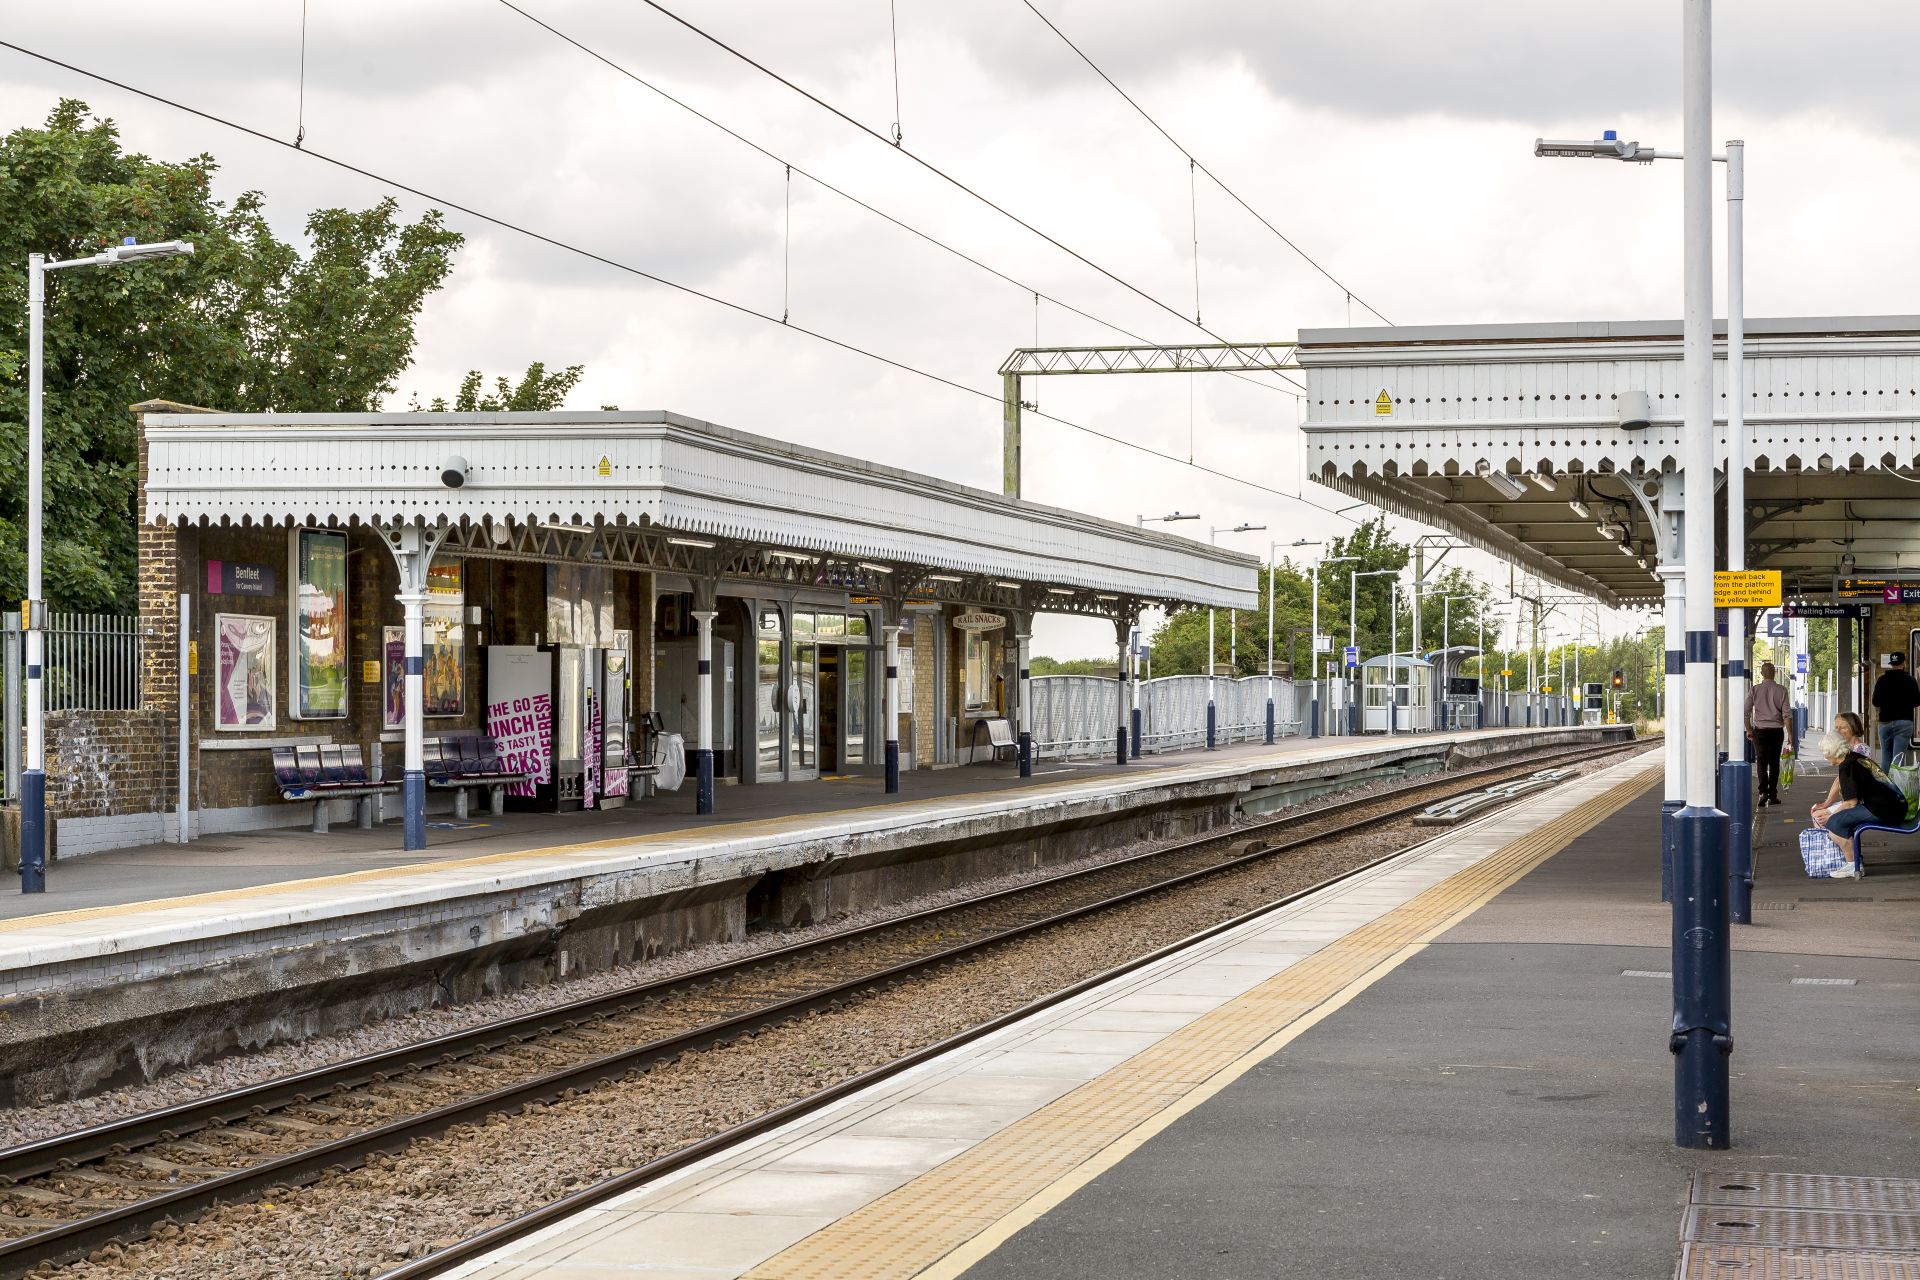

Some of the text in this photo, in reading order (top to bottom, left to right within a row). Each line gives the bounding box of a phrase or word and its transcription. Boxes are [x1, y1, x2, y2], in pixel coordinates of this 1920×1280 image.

[235, 566, 260, 580] Benfleet
[1845, 580, 1851, 589] 2
[1903, 590, 1920, 598] Exit
[1797, 607, 1823, 615] Waiting
[957, 614, 1001, 624] RAIL SNACKS
[1771, 617, 1784, 634] 2
[488, 697, 531, 719] THE GO
[506, 735, 536, 750] TASTY
